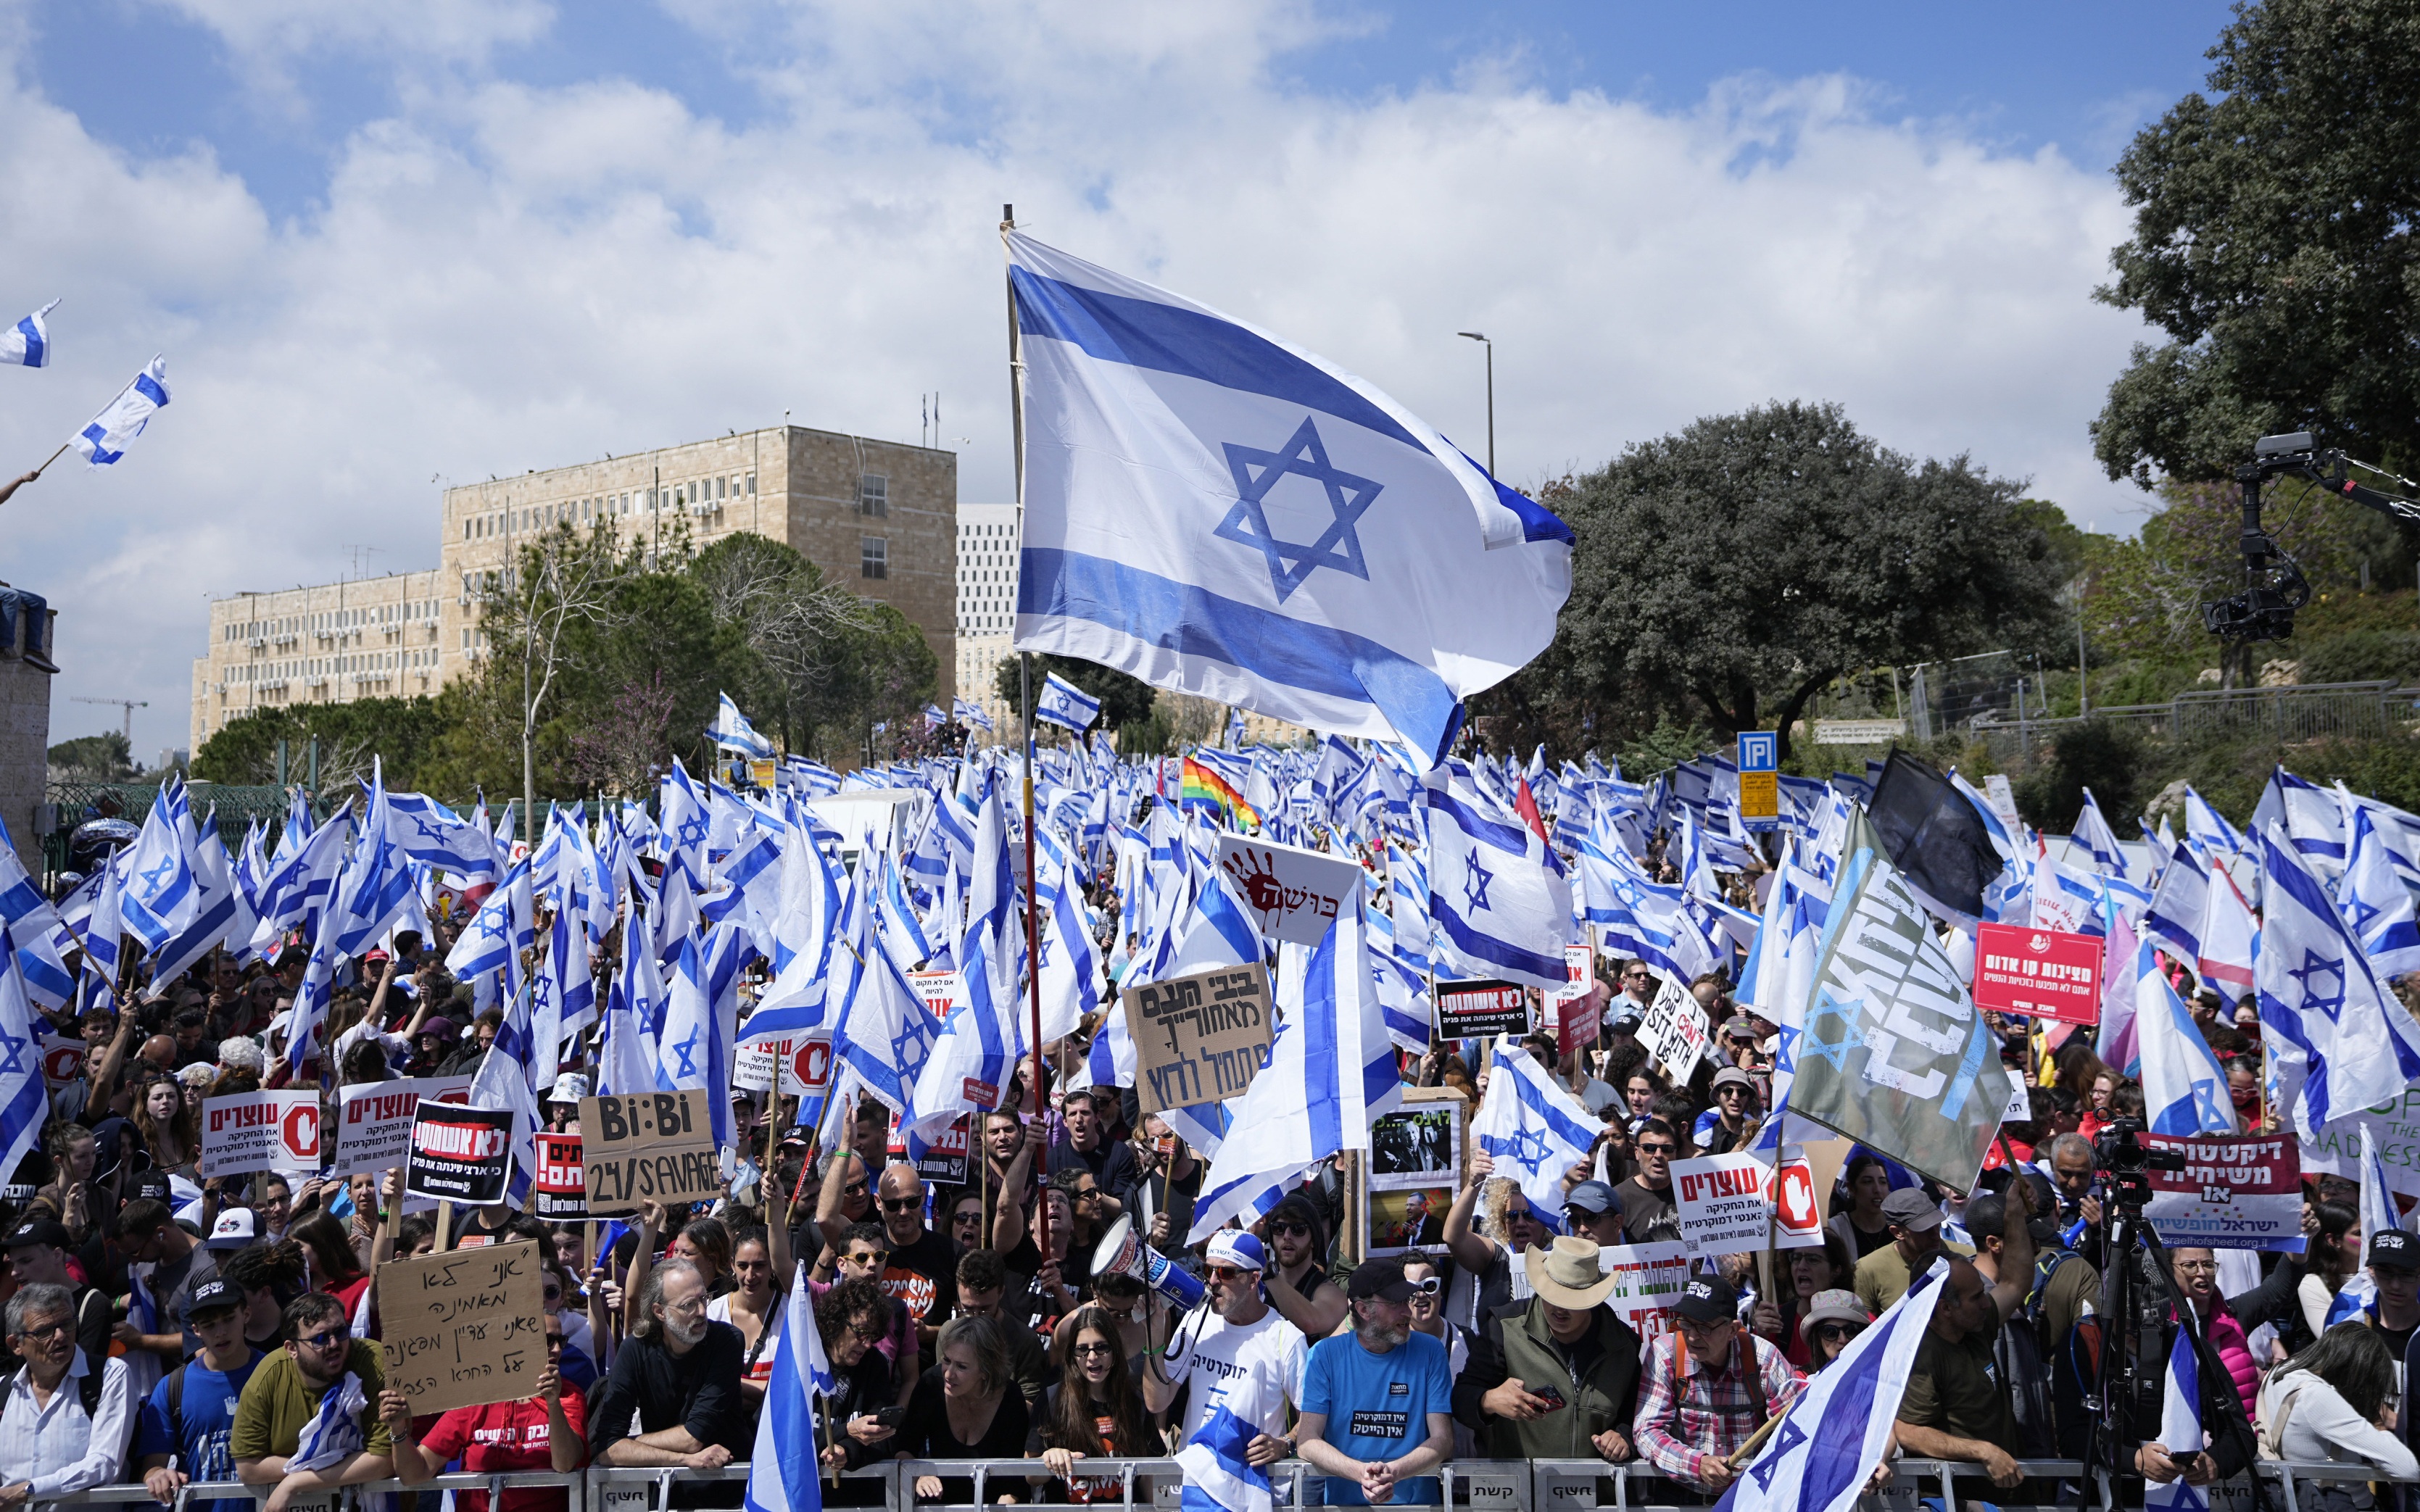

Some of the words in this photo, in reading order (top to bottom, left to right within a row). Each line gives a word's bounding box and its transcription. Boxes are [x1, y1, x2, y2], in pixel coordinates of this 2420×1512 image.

[1985, 954, 2019, 973] אדום
[2022, 959, 2038, 976] קו
[1984, 972, 2007, 984] הנשים
[2041, 962, 2092, 983] מציבות
[1208, 972, 1259, 1001] ביבי
[2007, 976, 2034, 988] בזכויות
[2035, 979, 2058, 991] תפגעו
[2059, 982, 2071, 993] לא
[2071, 985, 2090, 996] אתם
[1139, 980, 1202, 1018] העם
[1441, 992, 1499, 1014] אשתוק!
[1501, 989, 1522, 1008] לא
[2012, 1000, 2033, 1009] הנשים
[926, 998, 953, 1017] אזר
[2036, 1004, 2056, 1013] מאבק
[1647, 1008, 1671, 1039] SIT
[1668, 1026, 1694, 1069] WITH
[1656, 1040, 1672, 1063] US
[737, 1060, 766, 1072] דמוקרטית
[751, 1055, 774, 1064] חקיקה
[1146, 1052, 1203, 1110] לרוץ
[348, 1092, 420, 1124] עוצרים
[210, 1103, 278, 1131] עוצרים
[365, 1123, 401, 1136] החקיקה
[402, 1121, 413, 1130] ת
[228, 1129, 264, 1142] החקיקה
[341, 1135, 387, 1150] דמוקרטית
[415, 1121, 473, 1155] אשתוק!
[473, 1129, 506, 1156] לא
[206, 1140, 249, 1155] דמוקרטית
[252, 1139, 278, 1148] האנטי
[412, 1156, 425, 1168] פניה
[425, 1160, 436, 1170] את
[436, 1161, 463, 1173] שינתה
[922, 1160, 948, 1173] התנועה
[464, 1164, 487, 1176] ארצי
[491, 1166, 502, 1176] כי
[589, 1150, 720, 1202] 24/SAVAGE
[2163, 1166, 2272, 1185] משיחית
[1680, 1167, 1758, 1202] עוצרים
[2203, 1186, 2231, 1202] או
[552, 1198, 579, 1213] השלטון
[1706, 1201, 1745, 1215] החקיקה
[1747, 1199, 1762, 1208] את
[1684, 1216, 1732, 1229] דמוקרטית
[1735, 1211, 1762, 1222] האנטי
[2160, 1235, 2268, 1249] israelhofsheet.org.il
[423, 1260, 469, 1289] לא
[1613, 1255, 1688, 1297] להונגריה
[428, 1291, 506, 1323] מאמינה
[504, 1316, 539, 1340] שאני
[384, 1334, 441, 1366] מפגינה
[454, 1322, 488, 1363] עדיין
[503, 1350, 524, 1373] על
[1192, 1353, 1248, 1380] וקרטיה
[451, 1363, 492, 1382] החרא
[1355, 1413, 1392, 1422] דמוקרטיה
[1353, 1424, 1385, 1435] הייטק
[1386, 1426, 1403, 1437] אין
[1474, 1487, 1513, 1500] קשת
